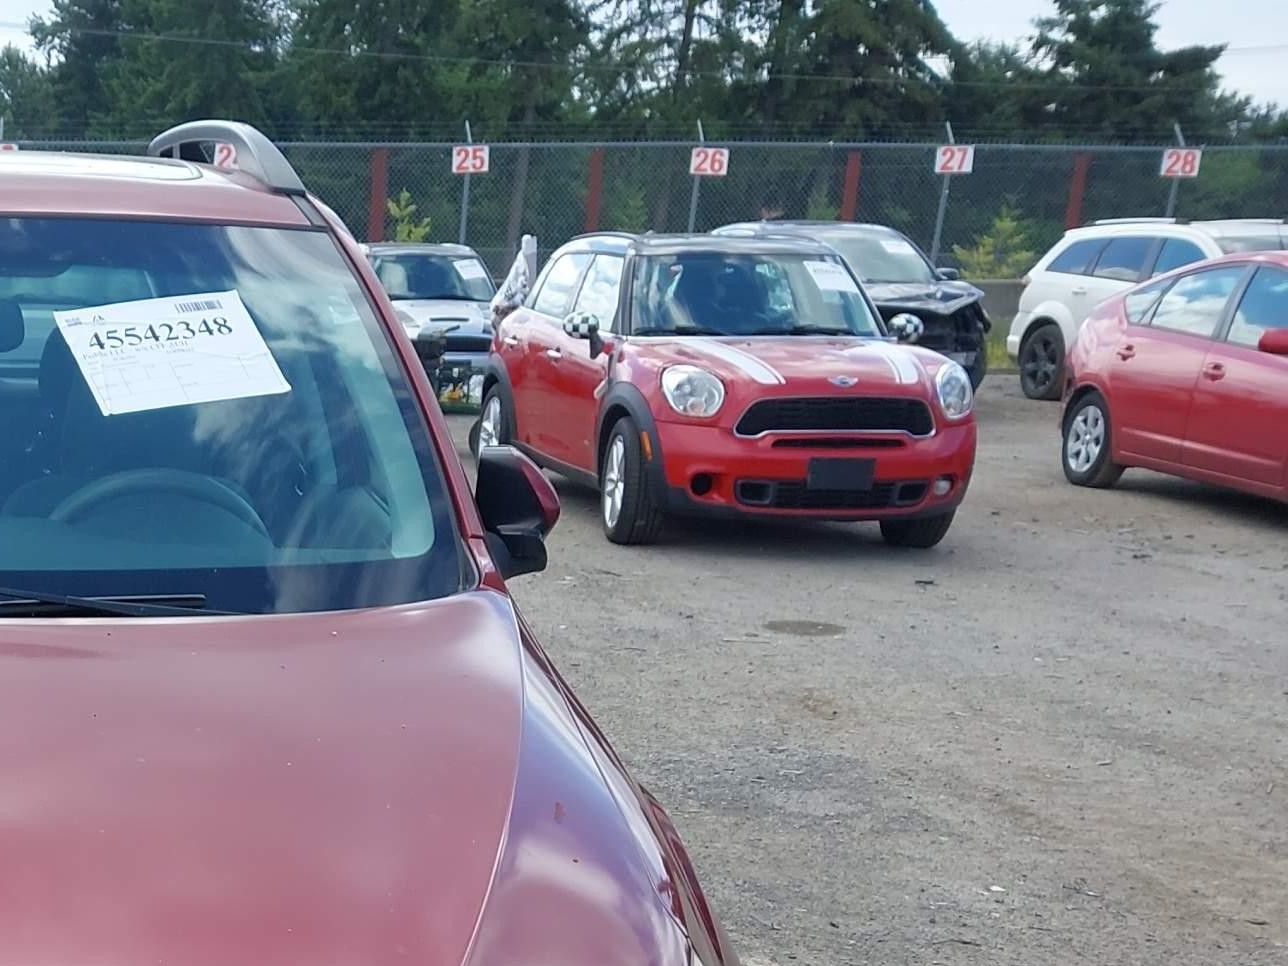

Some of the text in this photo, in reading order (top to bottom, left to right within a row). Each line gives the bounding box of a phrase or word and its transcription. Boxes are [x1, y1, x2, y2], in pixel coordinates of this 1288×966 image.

[218, 143, 238, 168] 2
[455, 146, 485, 171] 25
[694, 150, 724, 173] 26
[940, 147, 968, 171] 27
[1164, 150, 1197, 174] 28
[88, 316, 233, 350] 45542348
